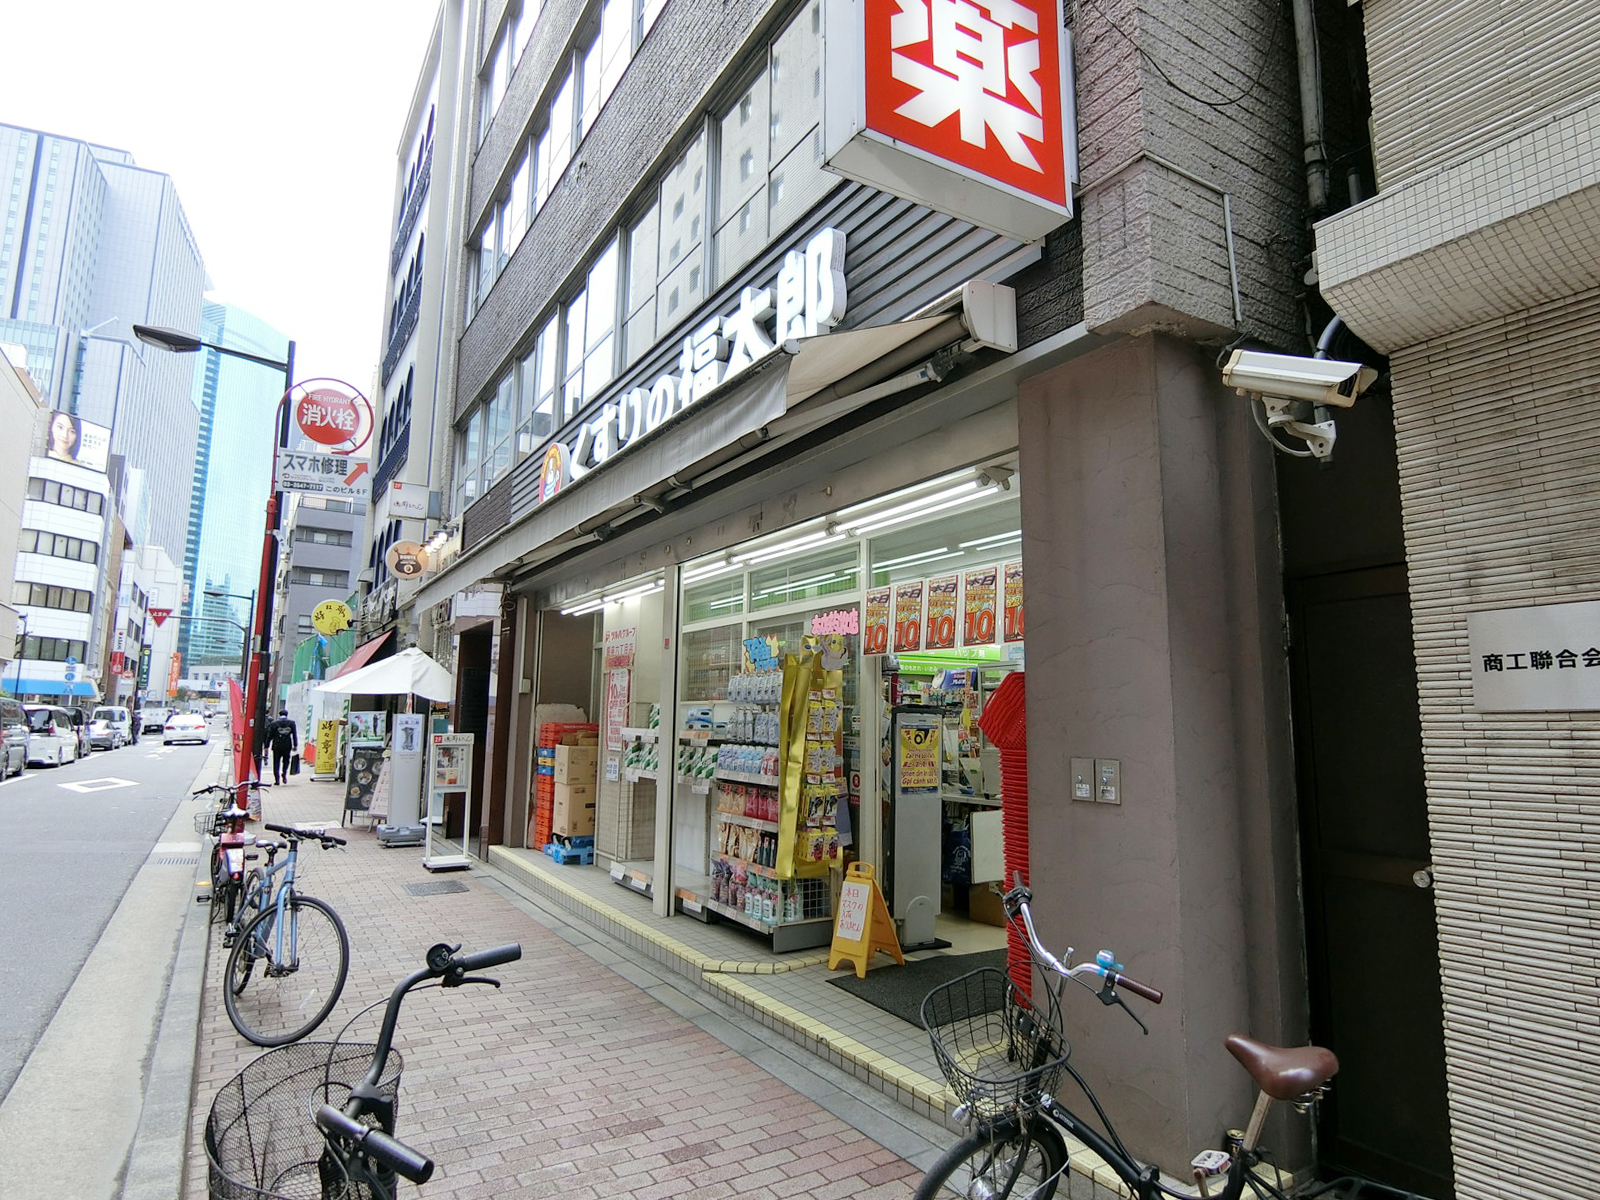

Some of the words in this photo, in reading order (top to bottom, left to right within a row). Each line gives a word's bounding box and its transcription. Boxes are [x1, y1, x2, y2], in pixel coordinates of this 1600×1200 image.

[569, 226, 847, 479] くすりの福太郎
[323, 395, 351, 405] HYDRANT
[302, 403, 356, 431] 消火栓
[283, 454, 348, 476] スマホ修理
[865, 623, 887, 651] 10
[894, 619, 919, 648] 10
[927, 614, 954, 645] 10
[965, 609, 994, 641] 10
[1482, 647, 1600, 672] 商工聯合会
[845, 886, 859, 898] 本日
[842, 900, 863, 911] マスクの
[842, 910, 853, 919] 入荷
[839, 919, 861, 933] ありません
